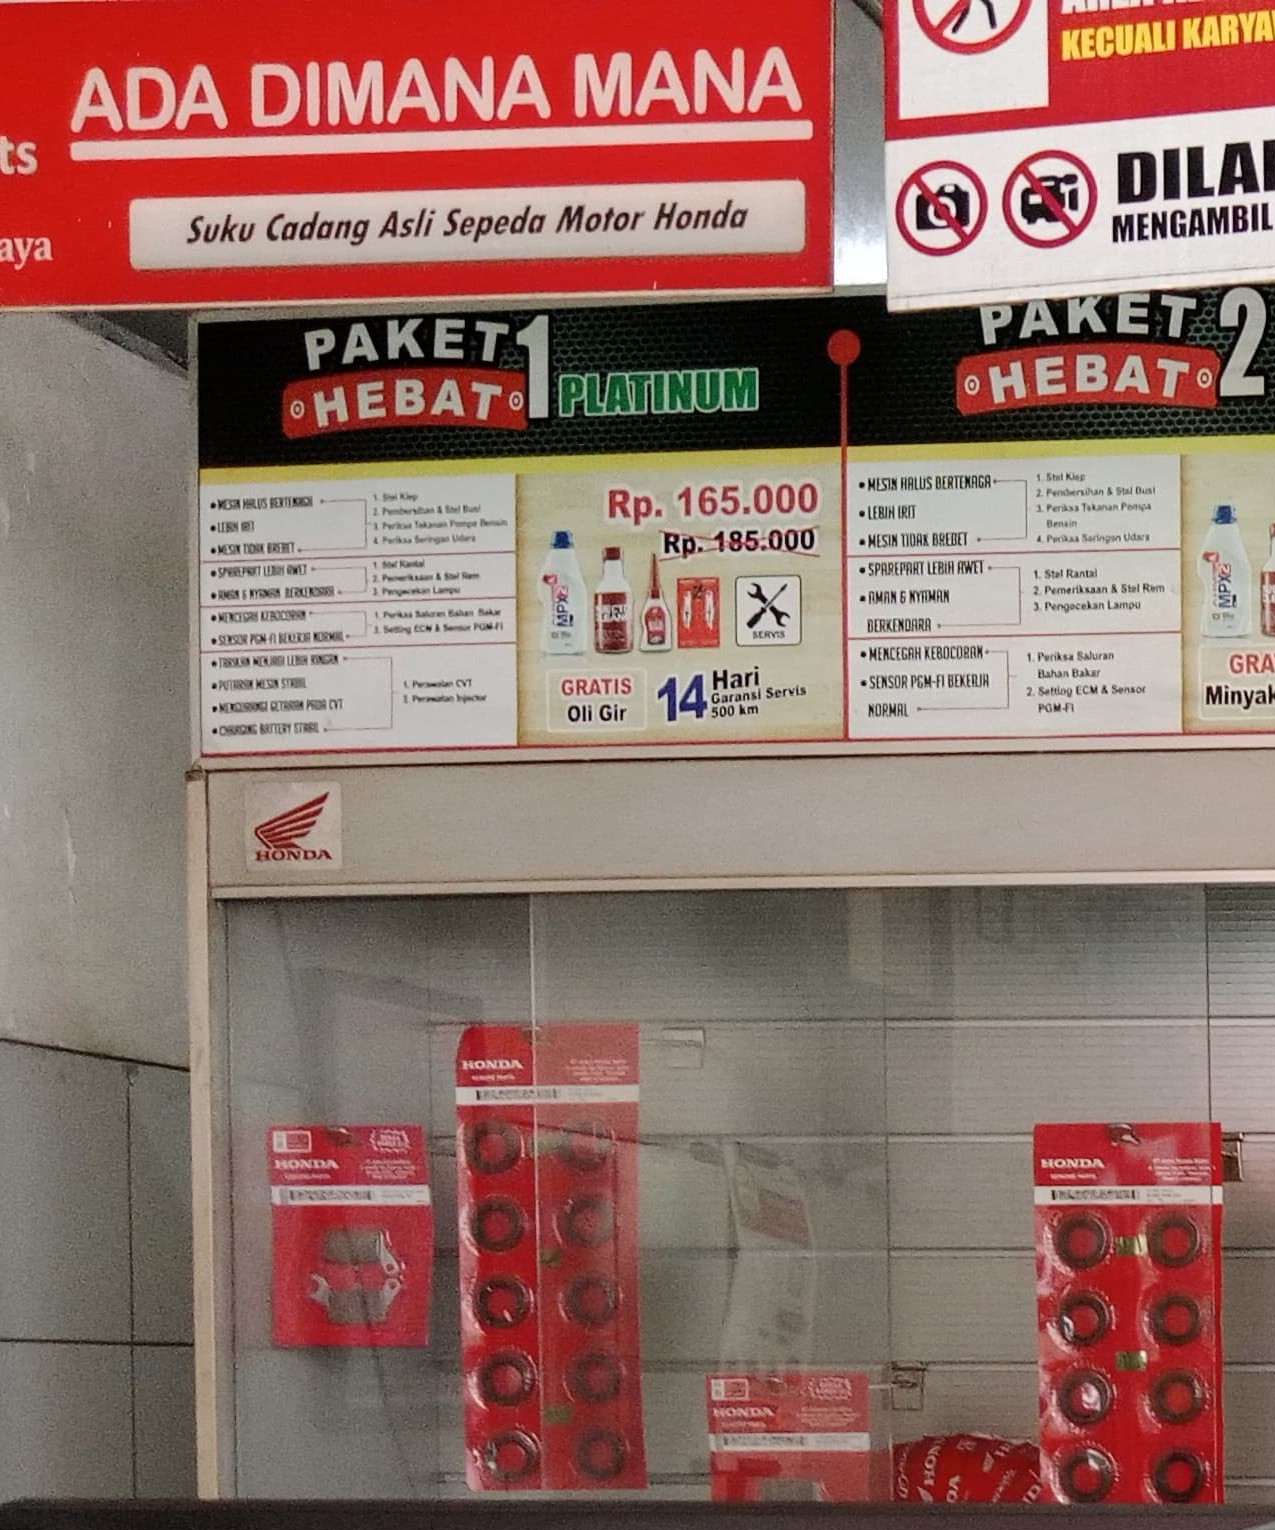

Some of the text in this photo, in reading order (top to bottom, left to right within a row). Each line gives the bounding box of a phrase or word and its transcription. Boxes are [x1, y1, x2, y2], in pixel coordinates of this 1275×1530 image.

[1062, 21, 1175, 61] KECUALI
[70, 46, 804, 133] ADA DIMANA MANA
[187, 201, 748, 247] Suku Cadang Asli Sepeda Motor Honda
[1112, 205, 1273, 243] MENGAMBIL
[304, 315, 509, 371] PAKET
[979, 287, 1267, 398] PAKET 2
[991, 353, 1189, 403] HEBAT
[313, 367, 759, 427] HEBAT PLATINUM
[608, 483, 818, 525] Rp. 165.000
[664, 529, 815, 558] Rp. 185.000
[561, 678, 632, 695] GRATIS
[658, 666, 759, 722] 14 Hari
[712, 686, 806, 704] Garansi Servis
[568, 704, 627, 722] Oli Gir
[712, 704, 758, 718] 500 km
[255, 849, 332, 861] HONDA
[462, 1059, 523, 1070] HONDA
[274, 1159, 338, 1170] HONDA
[1041, 1159, 1104, 1168] HONDA
[712, 1407, 774, 1418] HONDA
